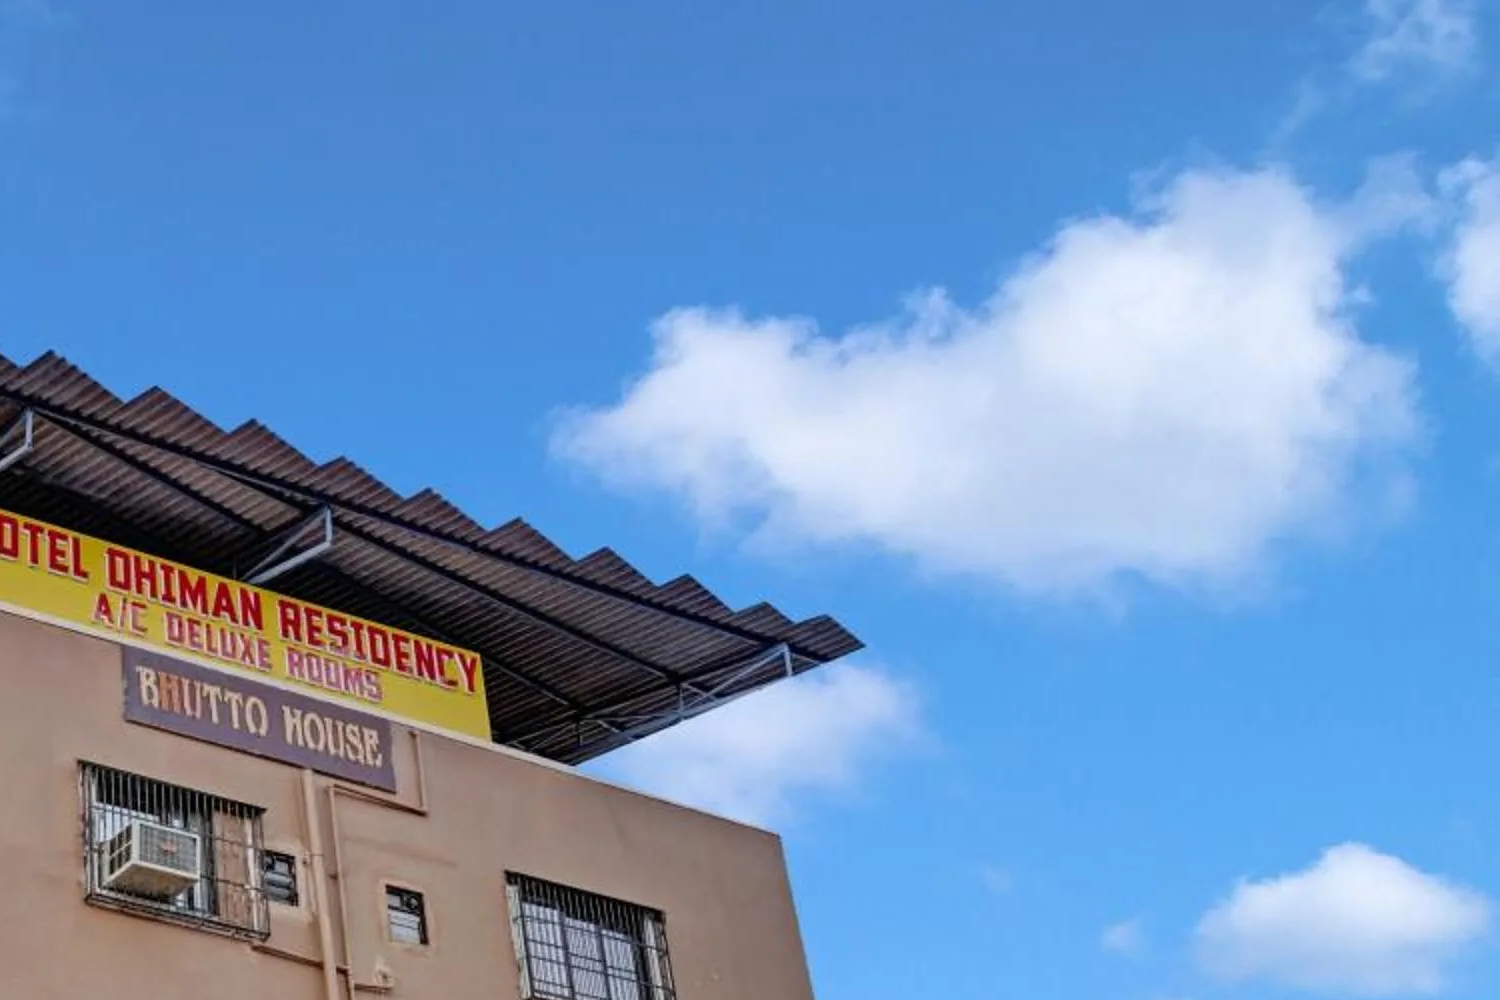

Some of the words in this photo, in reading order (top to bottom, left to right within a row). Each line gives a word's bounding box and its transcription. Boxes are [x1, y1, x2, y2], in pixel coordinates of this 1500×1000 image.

[91, 592, 149, 636] A/C
[164, 610, 273, 673] DELUXE
[285, 646, 384, 702] ROOMS
[105, 546, 264, 631] DHIMAN
[277, 598, 480, 697] RESIDENCY
[135, 665, 269, 738] BHUTTO
[281, 704, 384, 768] HOUSE
